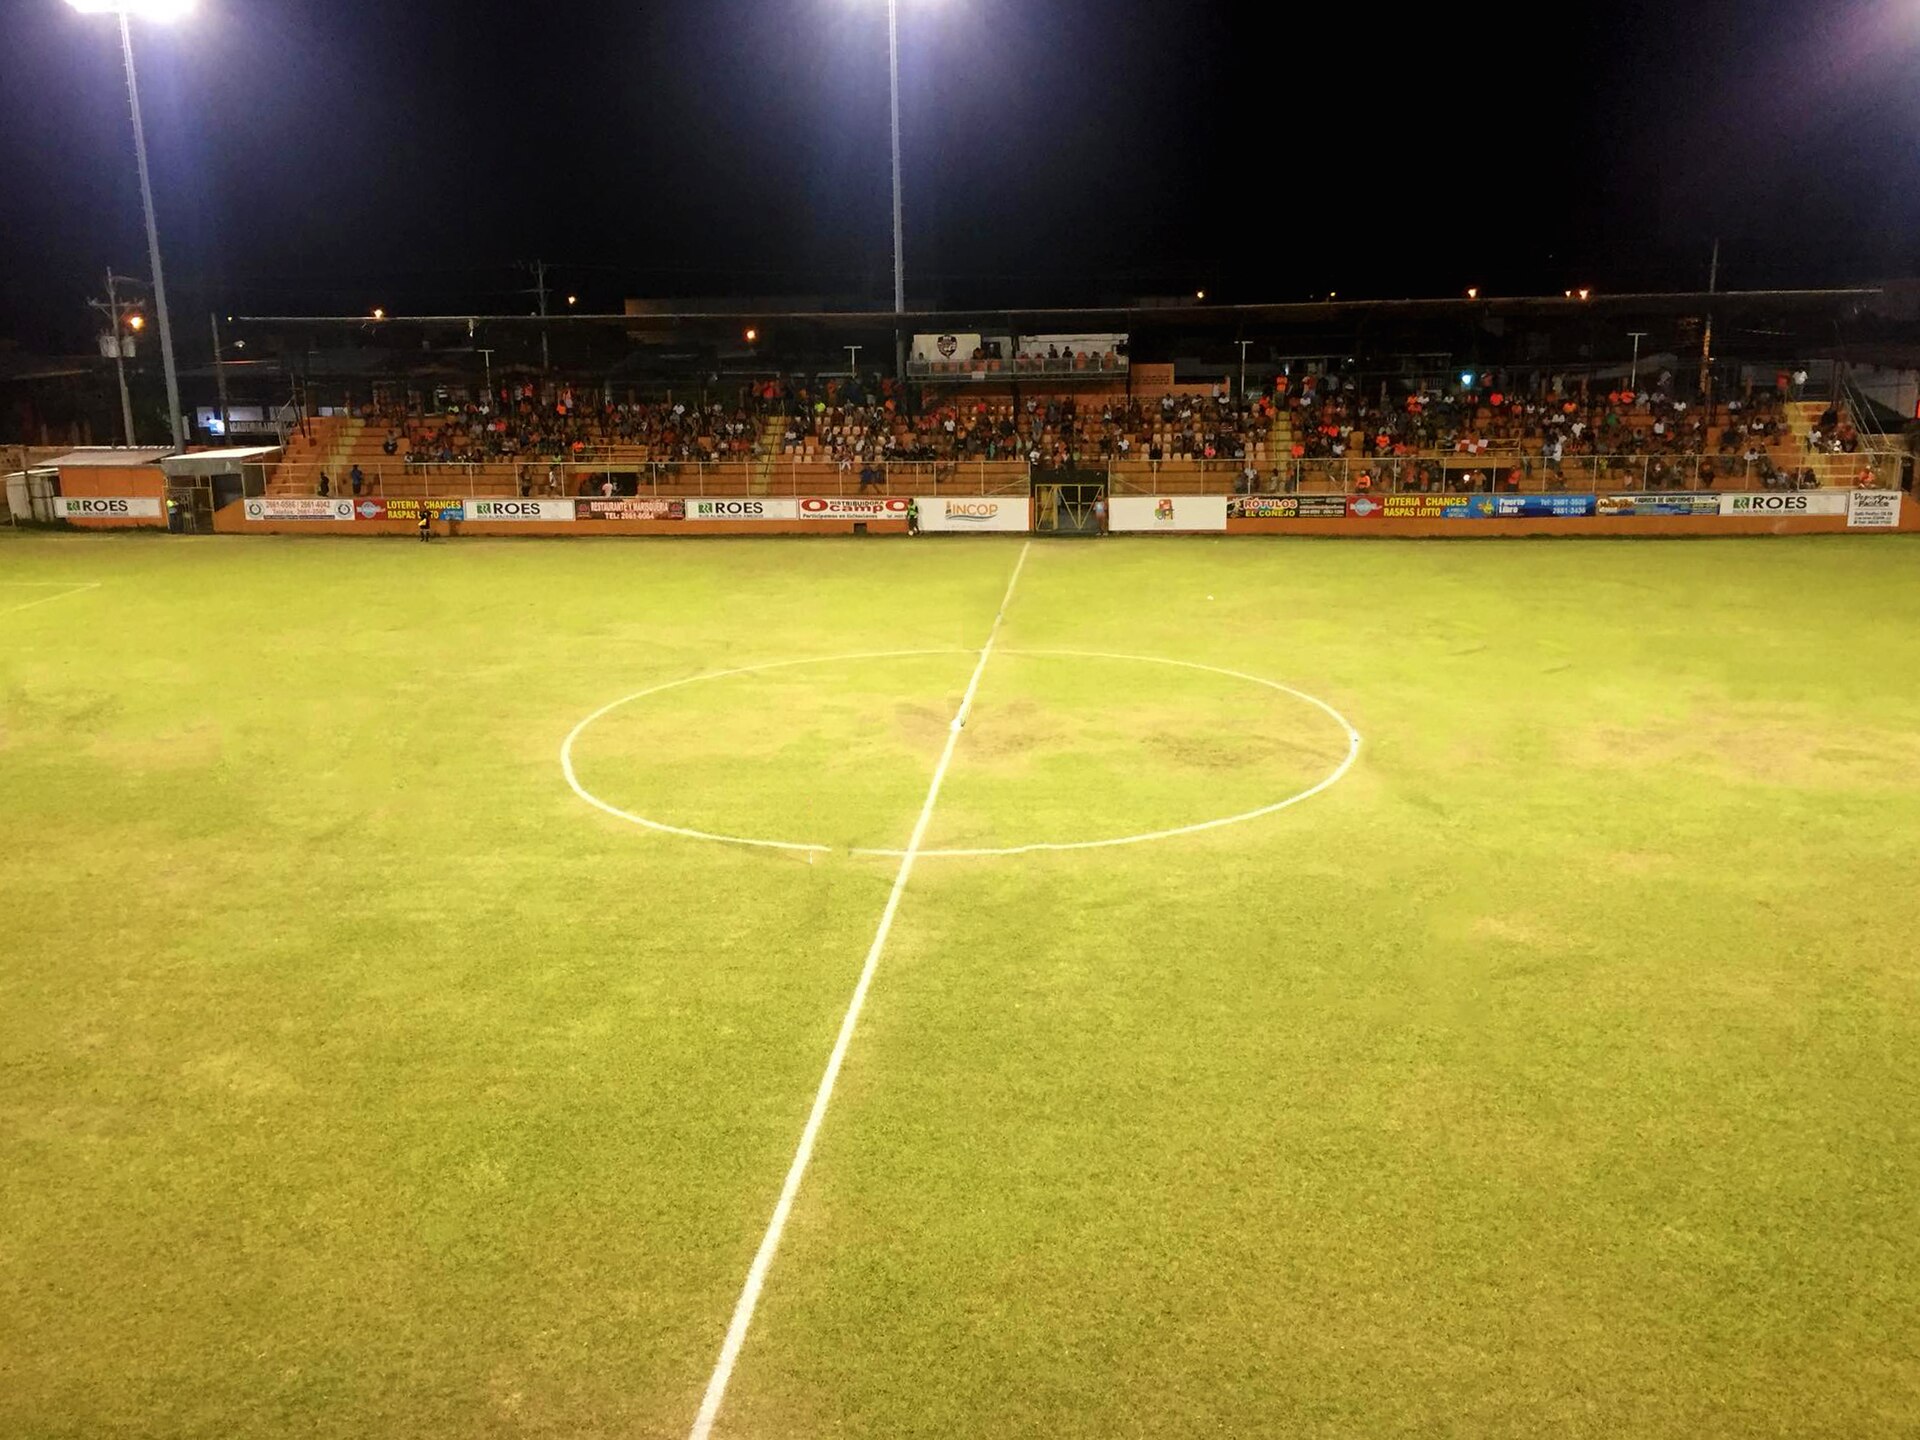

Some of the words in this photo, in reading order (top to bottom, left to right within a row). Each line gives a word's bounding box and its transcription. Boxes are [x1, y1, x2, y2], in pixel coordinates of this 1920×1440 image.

[83, 500, 128, 512] ROES
[386, 500, 420, 509] LOTERIA
[424, 500, 461, 509] CHANCES
[1243, 498, 1298, 509] RÓTULOS
[1384, 497, 1420, 506] LOTERIA
[1425, 497, 1467, 506] CHANCES
[1752, 497, 1807, 509] ROES
[494, 503, 541, 514] ROES
[715, 502, 763, 513] ROES
[952, 504, 999, 515] INCOP
[1384, 507, 1415, 517] RASPAS
[1416, 507, 1441, 517] LOTTO
[387, 510, 415, 519] RASPAS
